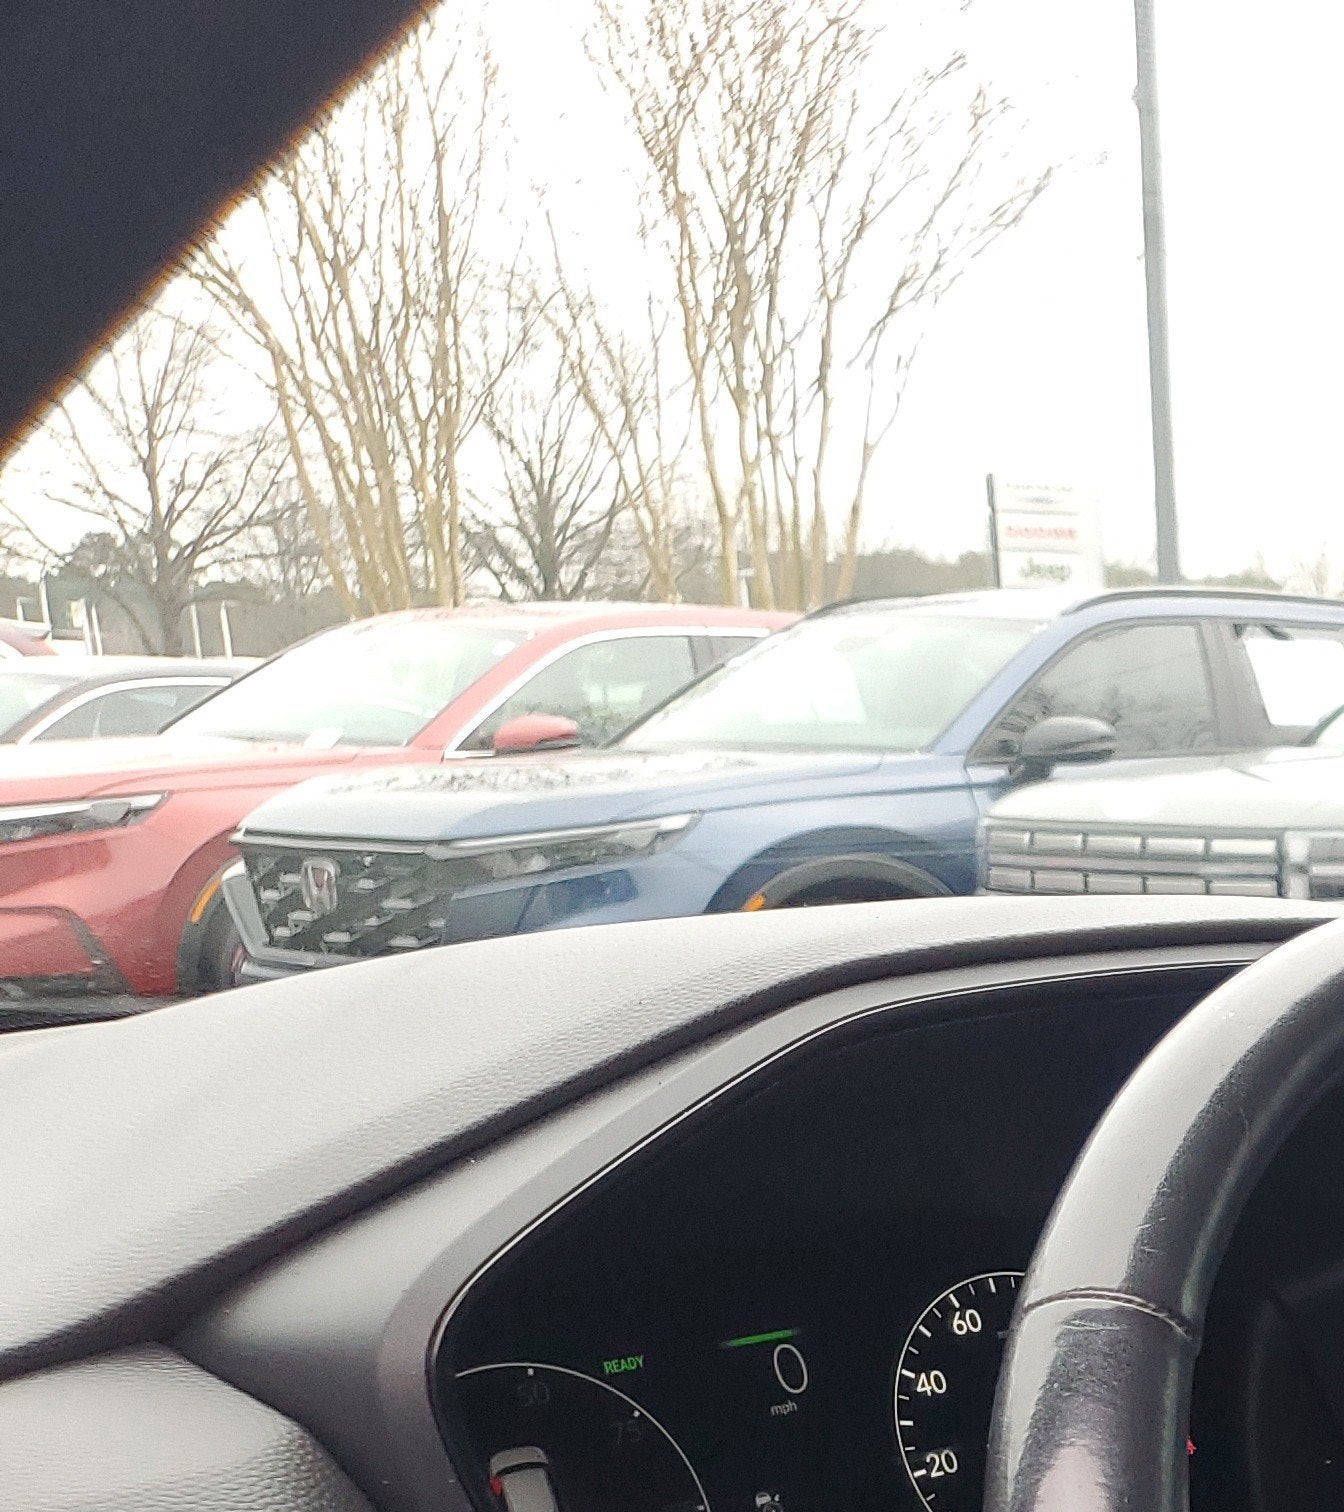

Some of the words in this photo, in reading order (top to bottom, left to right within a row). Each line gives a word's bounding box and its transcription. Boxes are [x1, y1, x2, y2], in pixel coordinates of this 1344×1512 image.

[951, 1308, 982, 1335] 60
[603, 1355, 644, 1375] READY
[773, 1344, 808, 1394] 0
[915, 1370, 947, 1396] 40
[770, 1400, 798, 1419] mph
[926, 1450, 958, 1476] 20
